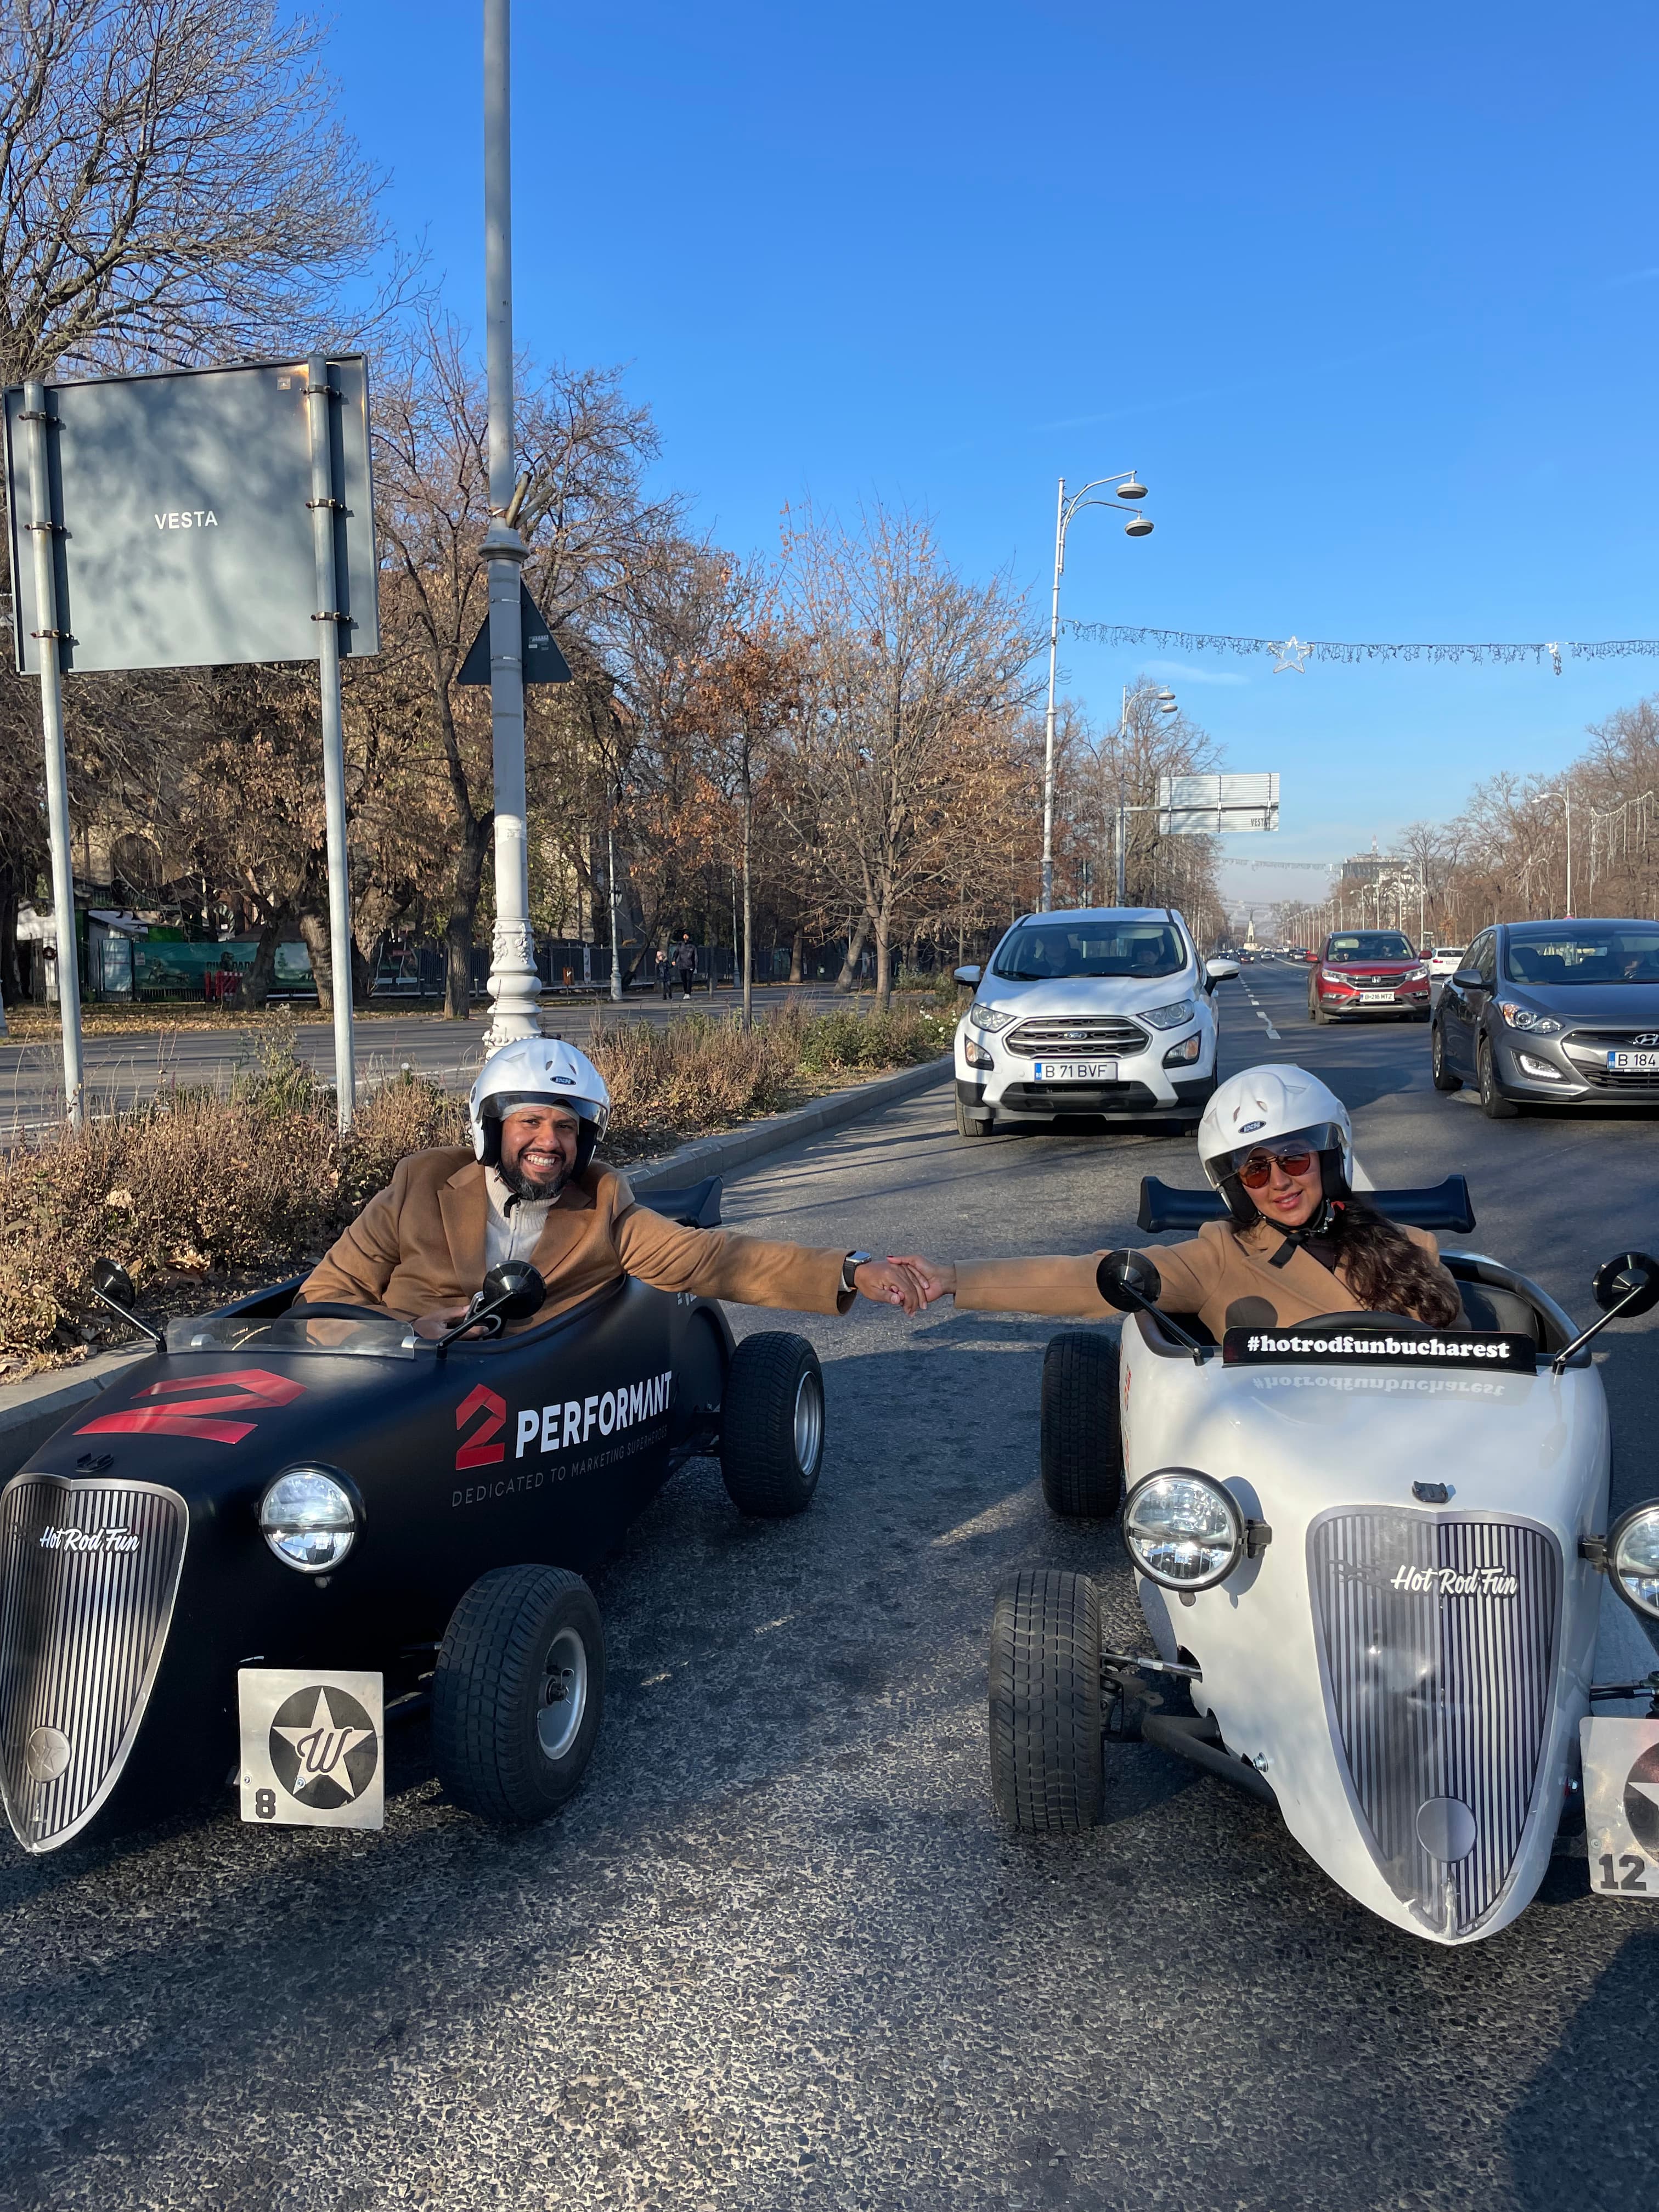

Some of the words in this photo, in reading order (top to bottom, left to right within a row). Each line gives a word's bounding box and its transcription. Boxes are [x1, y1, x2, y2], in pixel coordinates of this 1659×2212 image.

[154, 510, 218, 530] VESTA
[1046, 1065, 1055, 1077] B
[1060, 1065, 1073, 1077] 71
[1078, 1064, 1107, 1077] BVF
[1618, 1054, 1628, 1066] B
[1634, 1054, 1656, 1066] 184
[1247, 1335, 1510, 1358] #hotrodfunbucharest
[455, 1383, 506, 1471] 2
[515, 1370, 672, 1458] PERFORMANT
[452, 1472, 544, 1507] DEDICATED
[550, 1466, 566, 1483] TO
[571, 1446, 624, 1477] MARKETING
[40, 1525, 65, 1549] Hot
[64, 1528, 104, 1551] Rod
[105, 1528, 140, 1551] Fun
[1390, 1565, 1438, 1592] Hot
[1438, 1568, 1480, 1594] Rod
[1481, 1567, 1517, 1595] Fun
[297, 1728, 353, 1773] W
[255, 1788, 276, 1819] 8
[1599, 1853, 1647, 1891] 12
